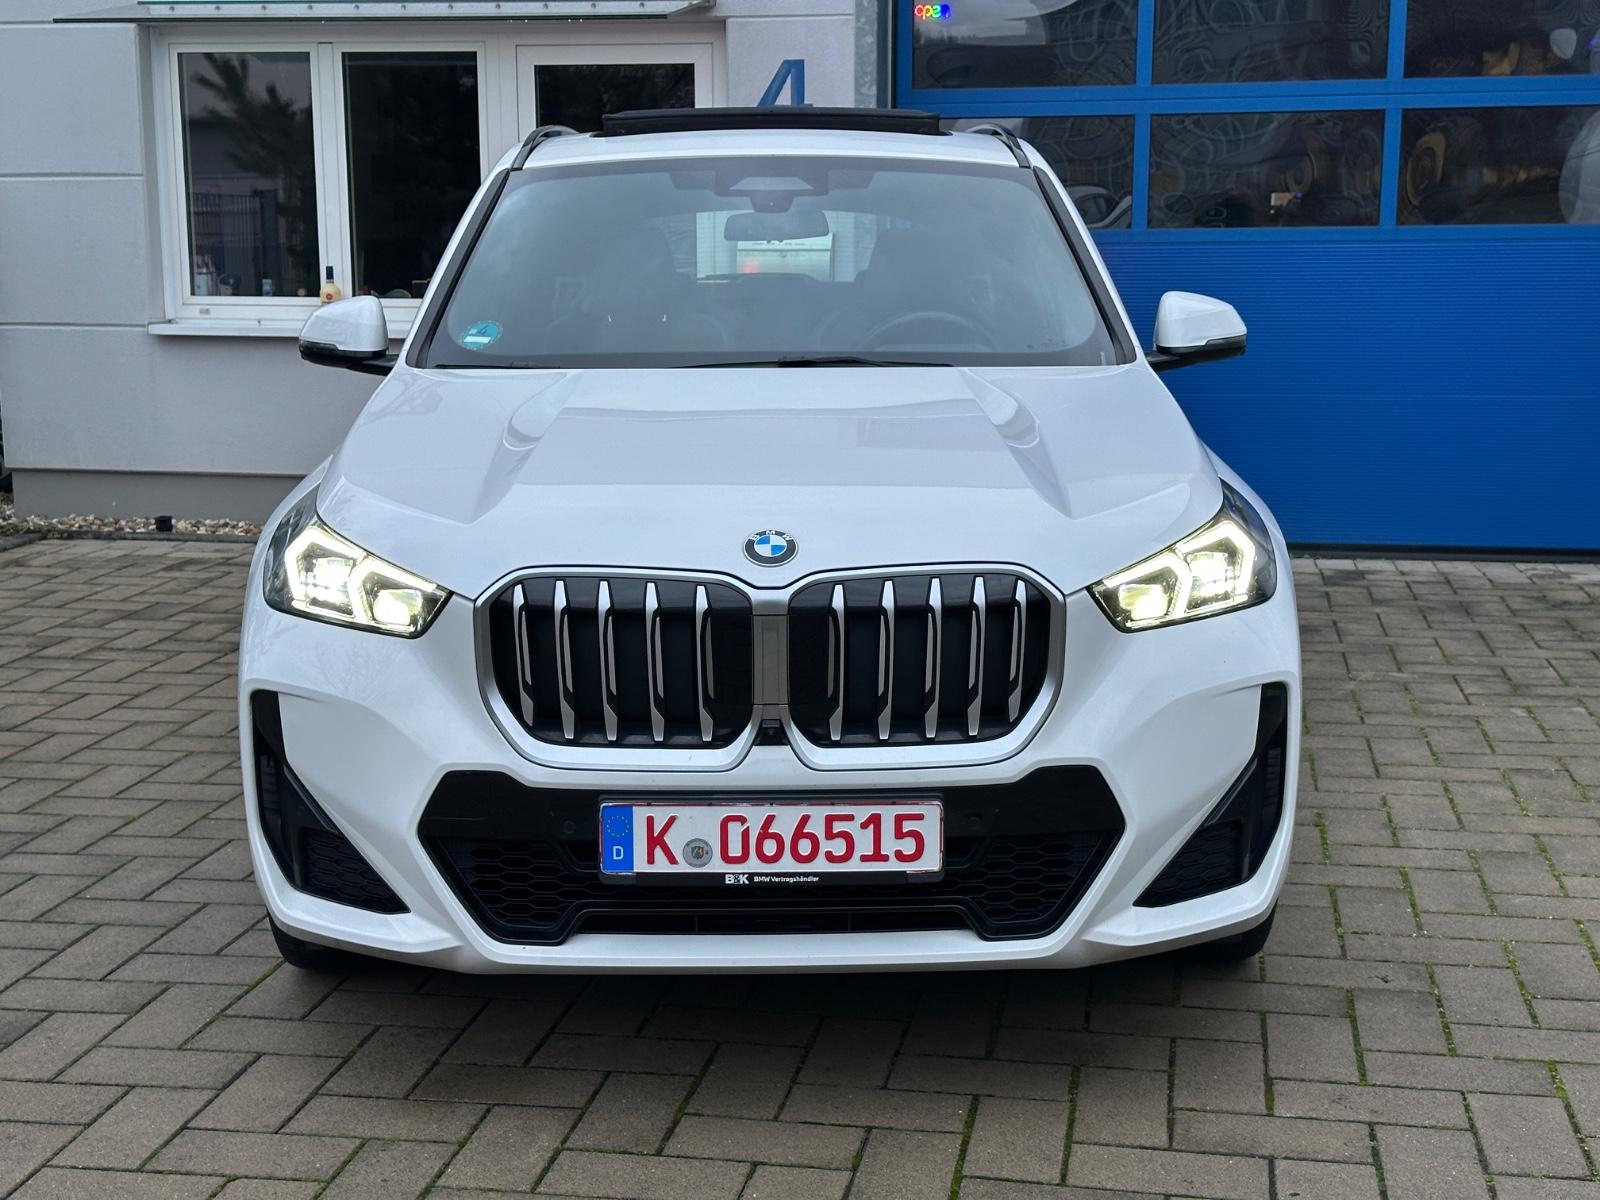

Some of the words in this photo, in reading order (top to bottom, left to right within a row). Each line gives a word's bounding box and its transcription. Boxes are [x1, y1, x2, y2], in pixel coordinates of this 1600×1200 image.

[914, 4, 951, 20] open
[646, 814, 680, 865] K
[719, 812, 925, 864] 066515
[612, 845, 624, 860] D
[725, 873, 750, 885] B&K
[771, 875, 820, 884] Vertragshändler
